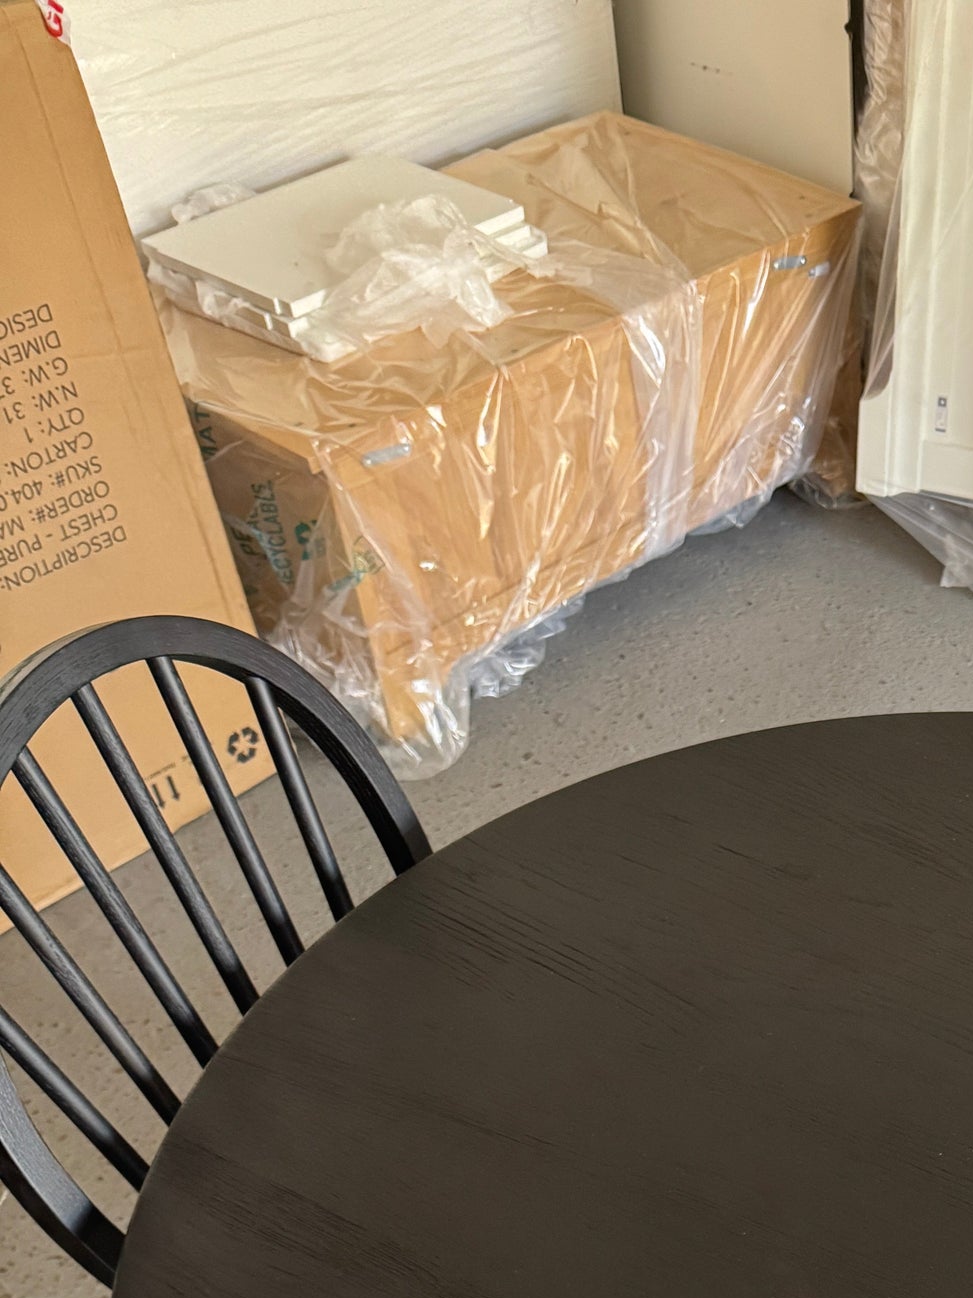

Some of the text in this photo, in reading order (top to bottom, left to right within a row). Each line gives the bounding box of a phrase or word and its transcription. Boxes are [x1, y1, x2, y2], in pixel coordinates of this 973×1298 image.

[0, 357, 68, 399] G.W: 3
[3, 381, 78, 424] N.W: 31
[24, 407, 84, 443] QTY: 1
[4, 431, 93, 477] CARTON:
[48, 455, 102, 488] SKU#:
[28, 480, 110, 523] ORDER#:
[60, 503, 118, 541] CHEST
[0, 533, 42, 568] PURE
[0, 525, 127, 590] DESCRIPTION:
